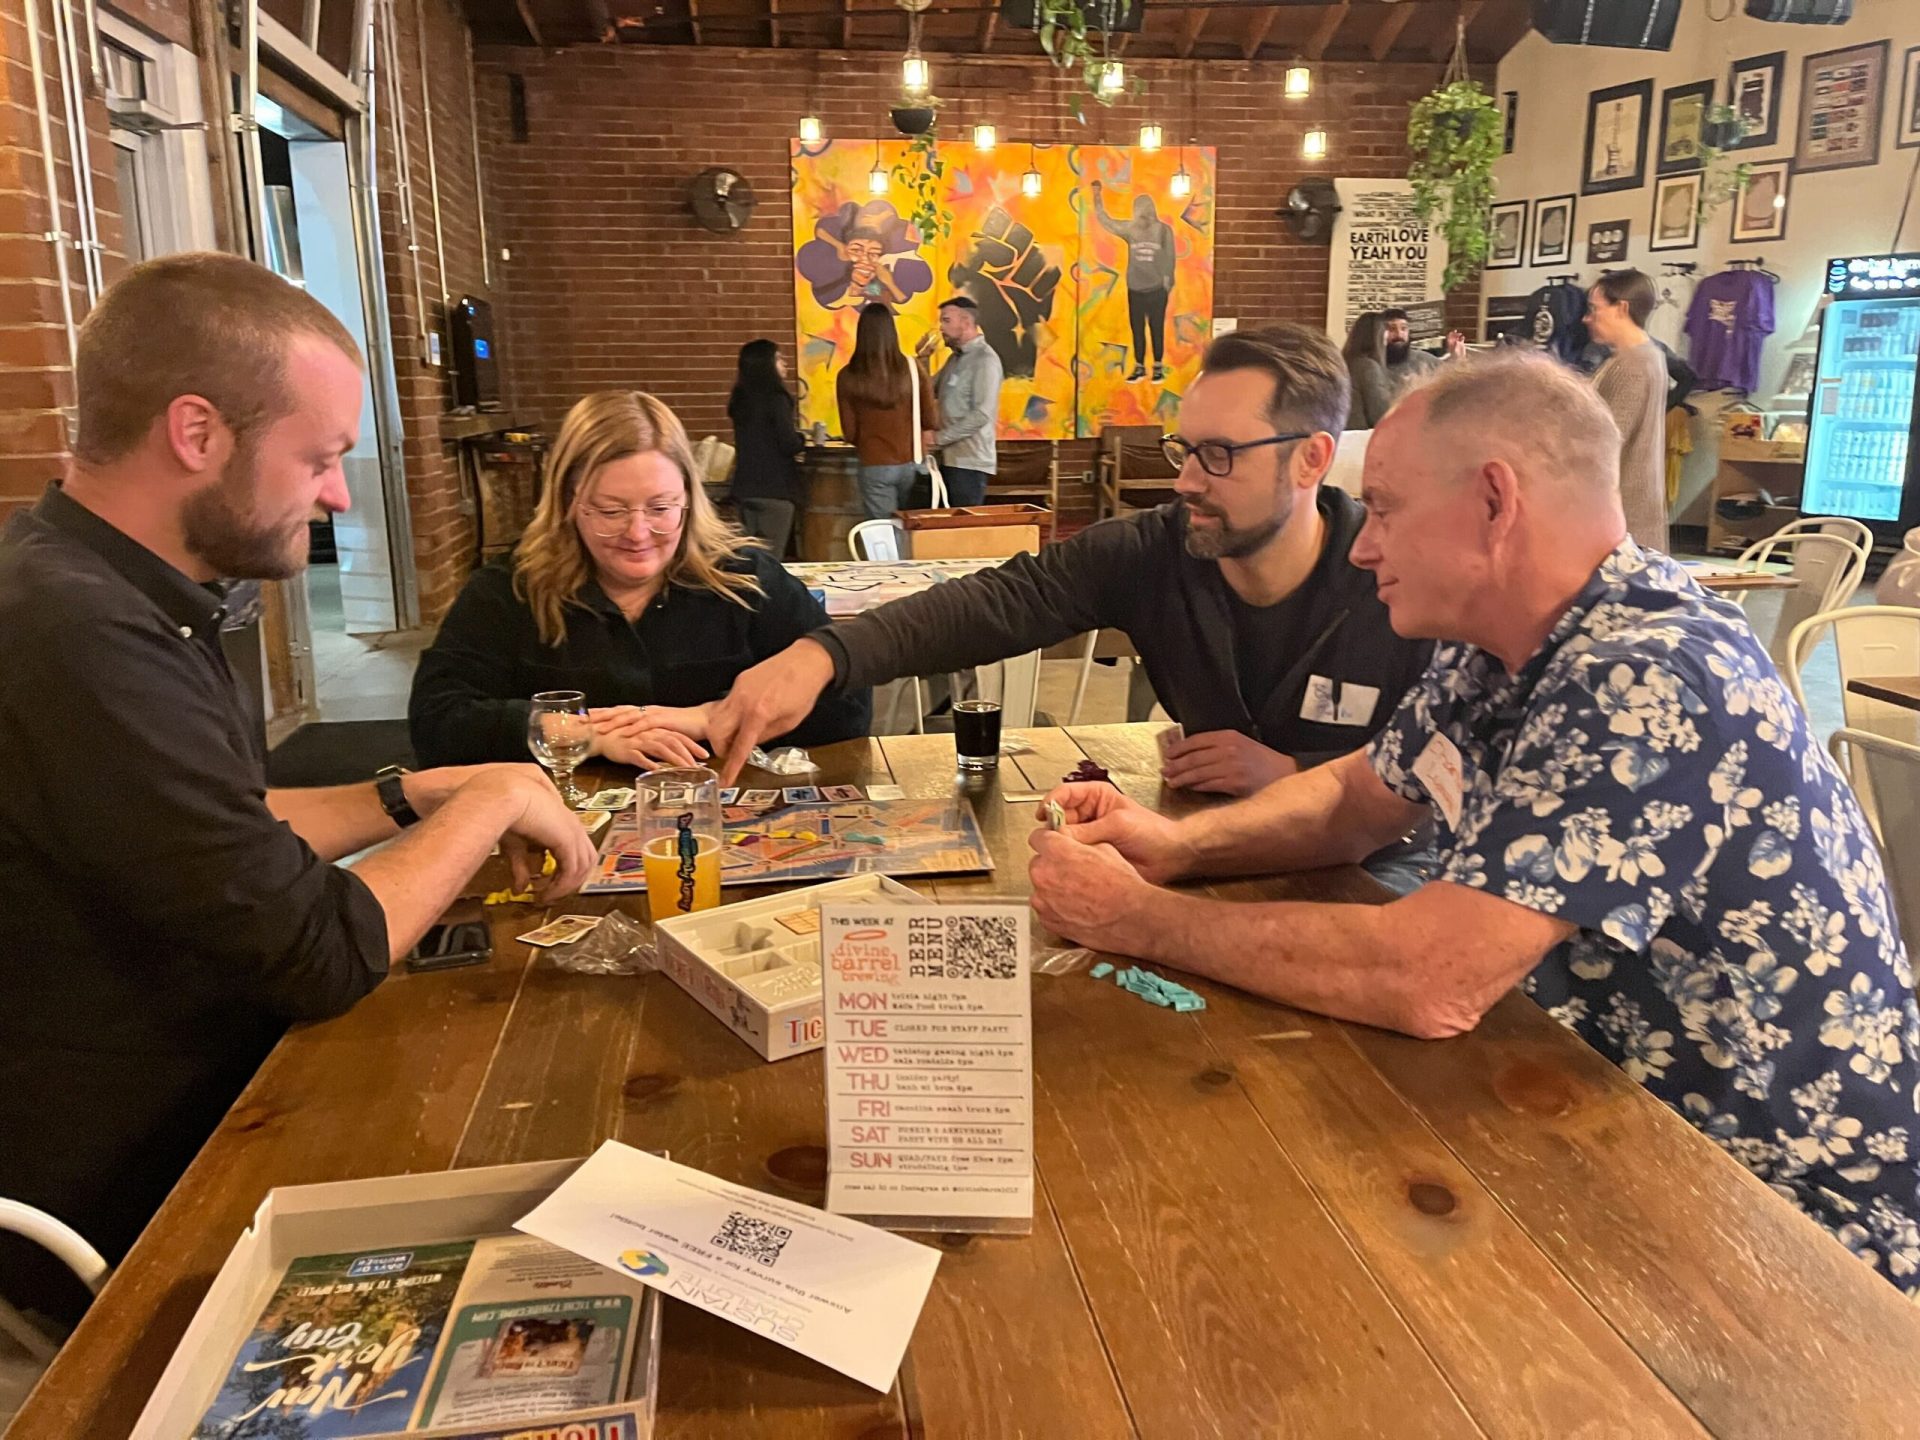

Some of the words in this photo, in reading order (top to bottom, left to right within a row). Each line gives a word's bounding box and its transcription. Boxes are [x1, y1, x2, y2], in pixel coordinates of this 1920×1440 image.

[1350, 232, 1390, 244] EARTH
[1392, 229, 1429, 242] LOVE
[1350, 246, 1391, 260] YEAH
[1395, 246, 1428, 260] YOU
[830, 917, 850, 926] THIS
[852, 918, 882, 926] WEEK
[884, 918, 894, 926] AT
[834, 943, 890, 957] divine
[909, 917, 925, 977] BEER
[927, 917, 944, 978] MENU
[831, 953, 900, 970] barrel
[841, 972, 900, 985] brewing
[839, 992, 888, 1010] MON
[846, 1020, 887, 1037] TUE
[838, 1046, 889, 1063] WED
[846, 1073, 889, 1091] THU
[858, 1100, 890, 1117] FRI
[851, 1126, 890, 1143] SAT
[850, 1152, 892, 1168] SUN
[609, 1214, 646, 1231] bottle!
[647, 1229, 680, 1244] water
[357, 1255, 407, 1265] WONDER
[681, 1243, 713, 1260] FREE
[380, 1262, 404, 1272] DAYS
[724, 1260, 742, 1271] for
[377, 1279, 391, 1289] TO
[395, 1273, 442, 1287] WELCOME
[746, 1268, 781, 1285] survey
[334, 1284, 352, 1294] BIG
[352, 1281, 374, 1292] THE
[786, 1285, 806, 1297] this
[678, 1272, 805, 1331] CHARLOTTE
[810, 1295, 852, 1314] Answer
[669, 1280, 799, 1343] SUSTAIN
[275, 1321, 363, 1350] City
[243, 1328, 424, 1383] York
[537, 1361, 574, 1369] TICKET
[238, 1372, 408, 1421] New
